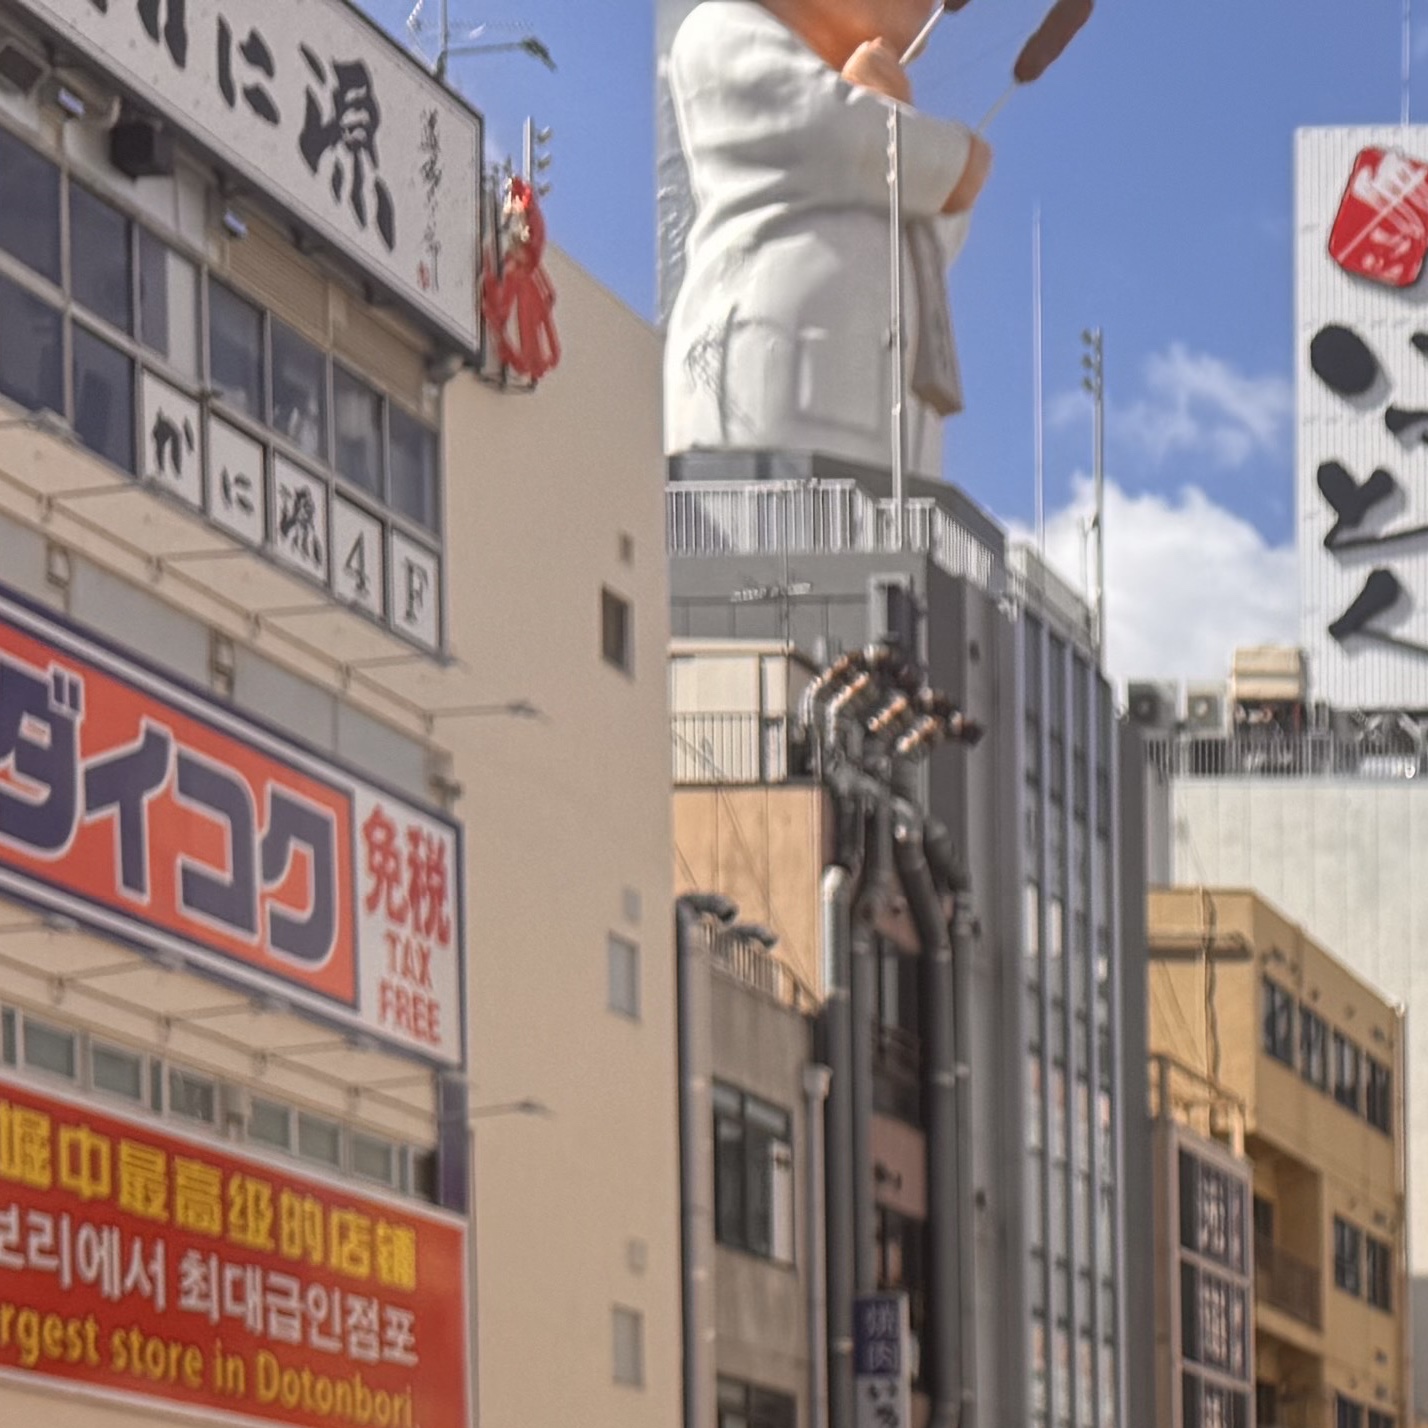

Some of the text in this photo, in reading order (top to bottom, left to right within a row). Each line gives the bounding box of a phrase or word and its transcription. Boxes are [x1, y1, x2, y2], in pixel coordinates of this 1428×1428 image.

[152, 406, 430, 626] かに源4F
[363, 807, 450, 946] 免税
[385, 932, 432, 988] TAX
[379, 983, 442, 1045] FREE
[110, 1326, 204, 1388] store
[215, 1337, 246, 1396] in
